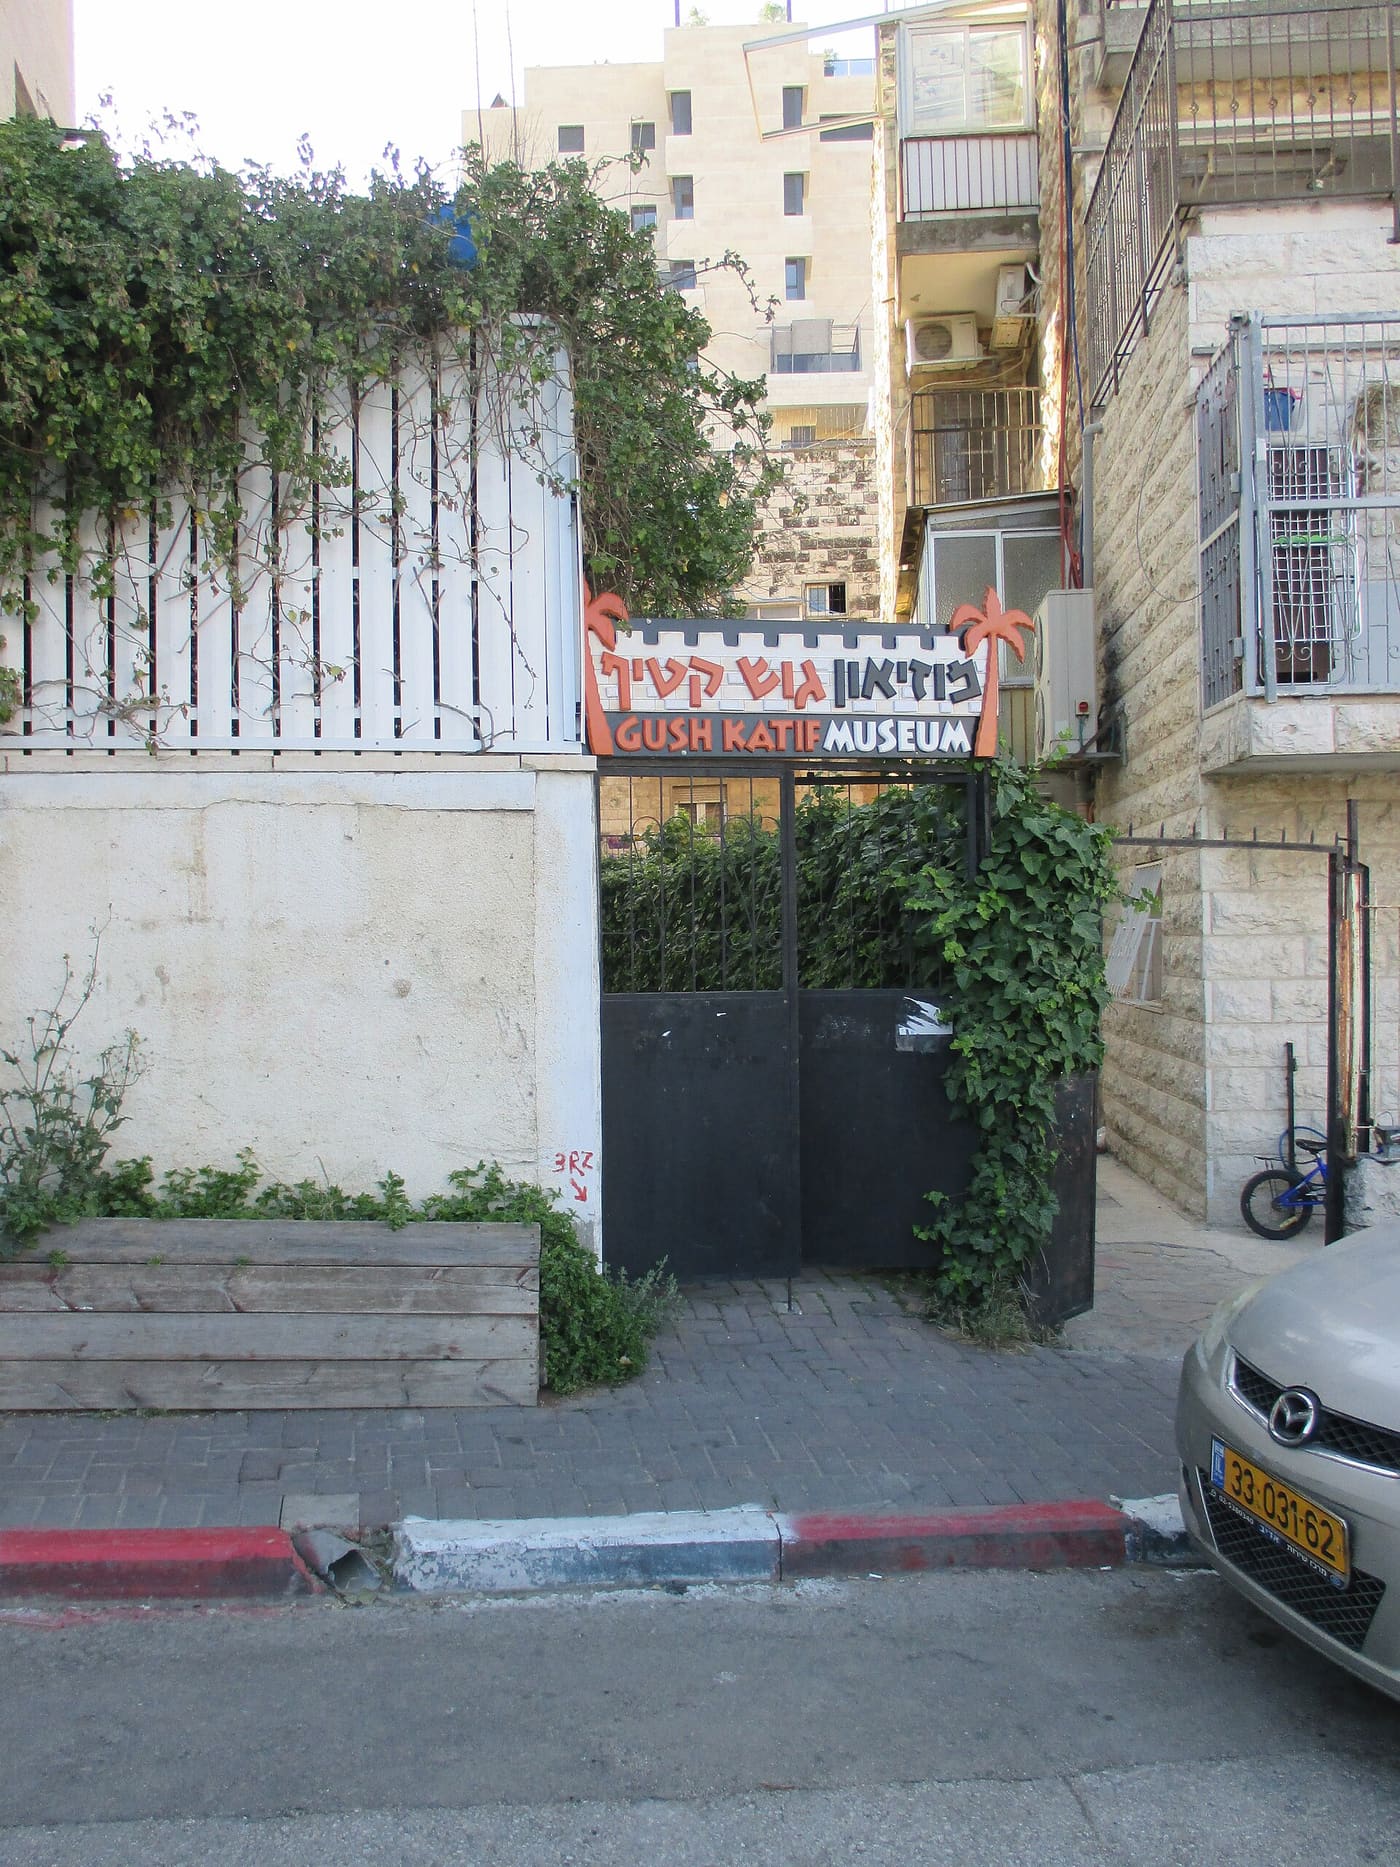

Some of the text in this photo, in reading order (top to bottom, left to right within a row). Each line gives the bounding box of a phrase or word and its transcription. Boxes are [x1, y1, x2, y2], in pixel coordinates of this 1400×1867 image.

[601, 651, 982, 711] מוזיאון גוש קטיף
[615, 715, 972, 753] GUSH KATIF MUSEUM
